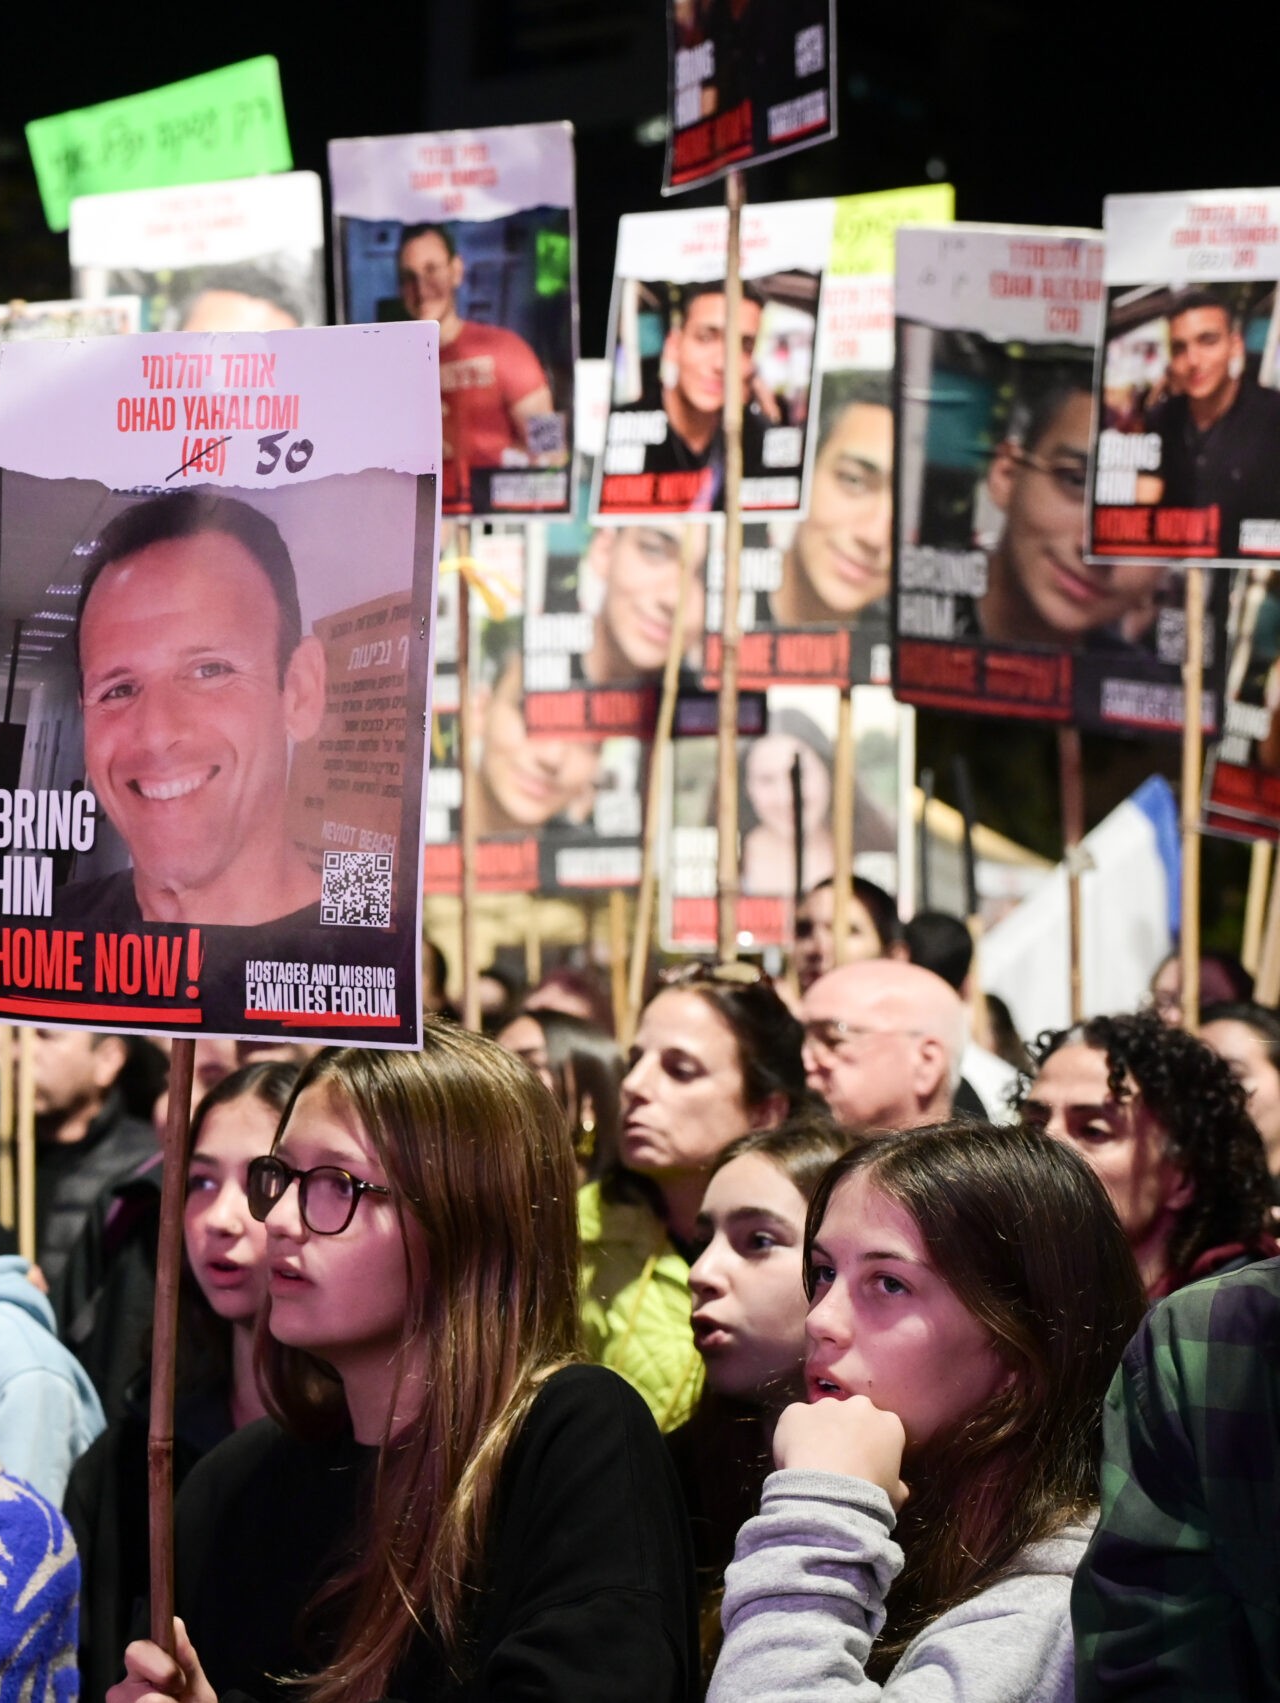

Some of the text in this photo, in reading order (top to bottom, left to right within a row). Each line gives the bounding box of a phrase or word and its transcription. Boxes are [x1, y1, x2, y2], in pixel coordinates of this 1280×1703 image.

[142, 351, 277, 390] אוהד יהלומי
[117, 394, 300, 432] OHAD YAHALOMI
[180, 435, 227, 477] (49)
[256, 430, 315, 476] 50
[321, 820, 358, 846] NEVIOT
[94, 928, 205, 999] NOW!
[245, 960, 396, 989] HOSTAGES AND MISSING
[246, 981, 397, 1018] FAMILIES FORUM
